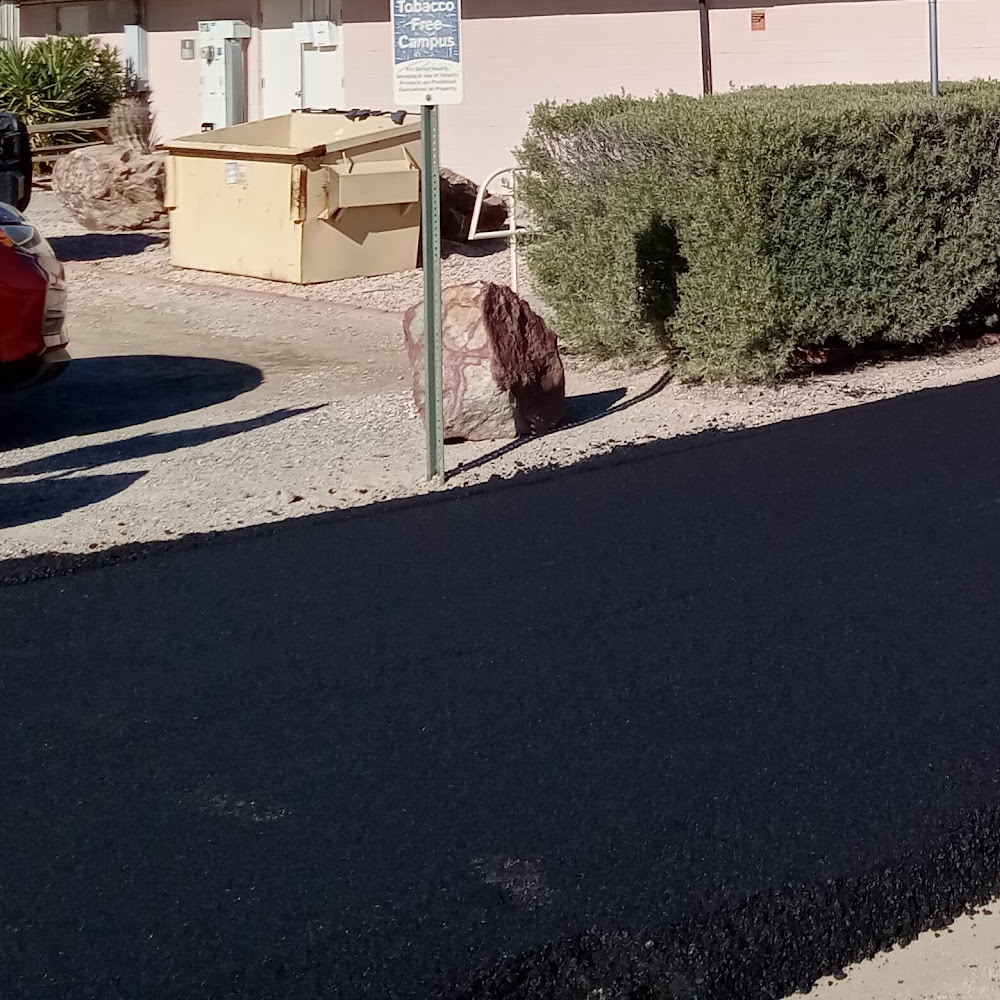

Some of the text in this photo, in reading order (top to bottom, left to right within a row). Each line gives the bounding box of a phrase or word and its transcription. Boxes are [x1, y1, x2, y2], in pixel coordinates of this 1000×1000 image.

[396, 0, 455, 13] Tobacco
[411, 18, 442, 31] Free
[398, 35, 455, 50] Campus
